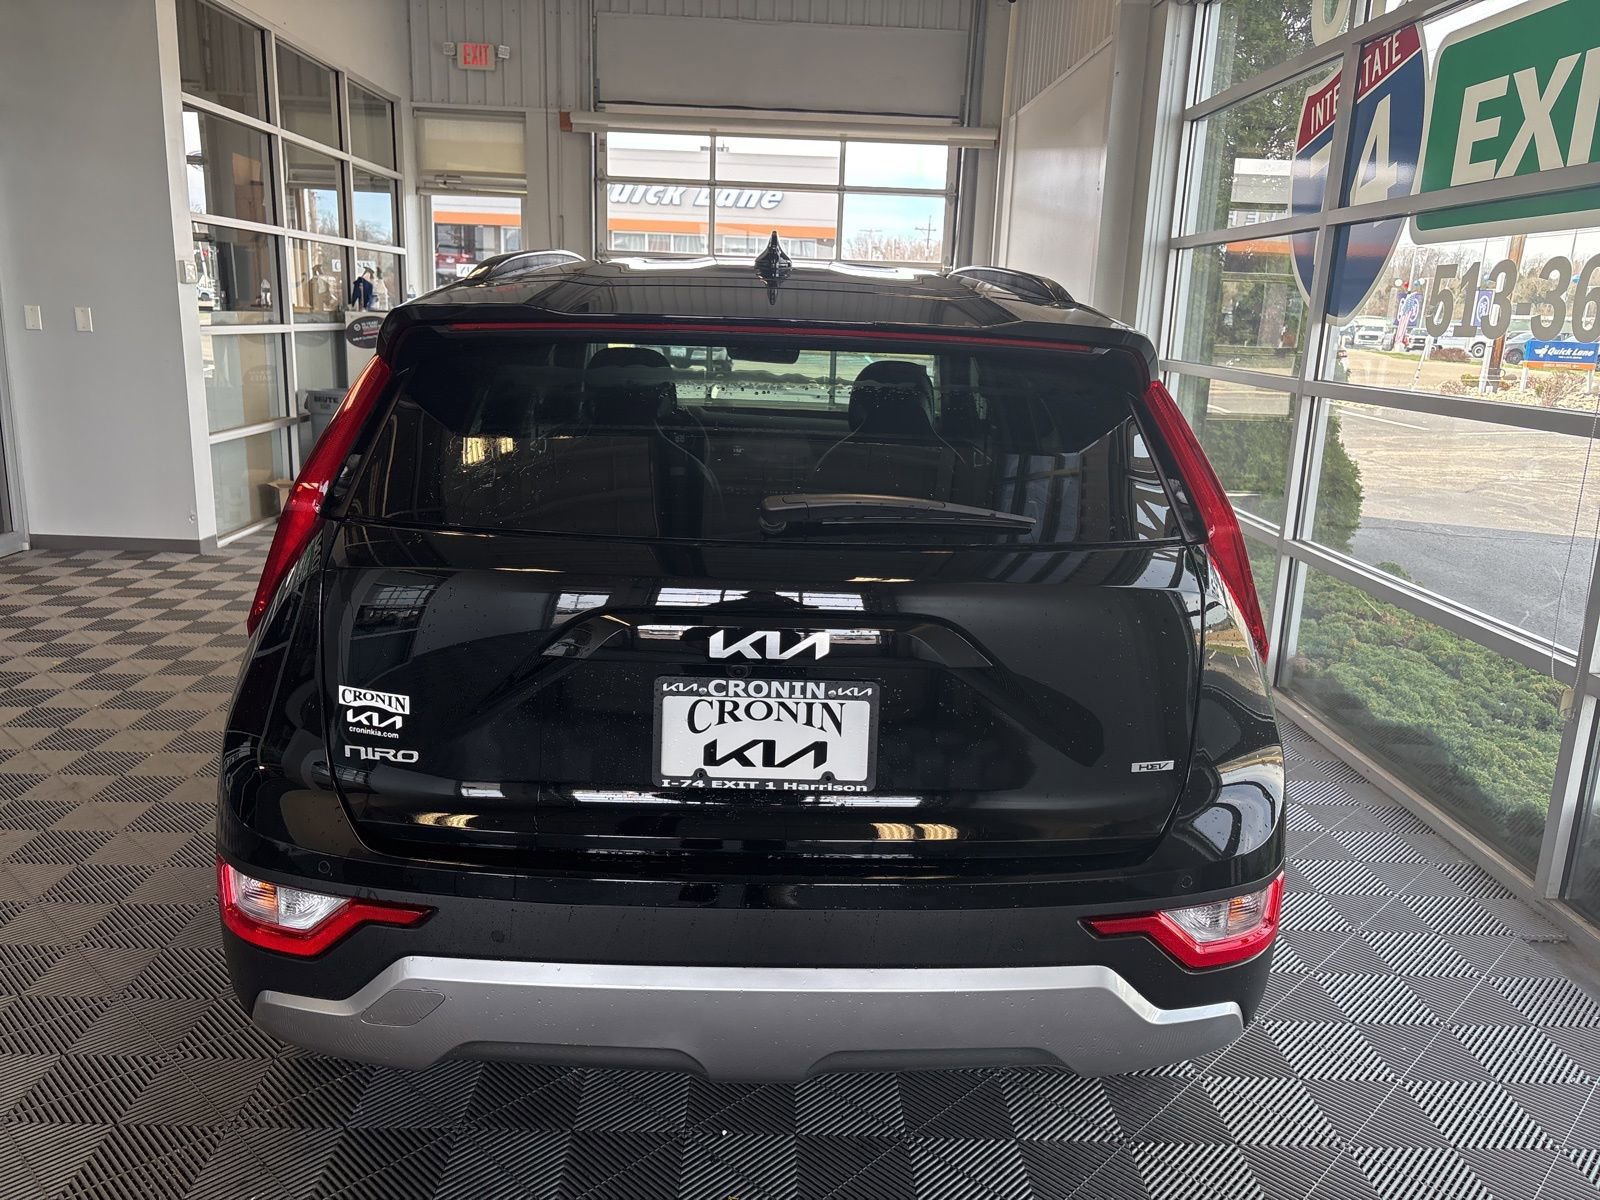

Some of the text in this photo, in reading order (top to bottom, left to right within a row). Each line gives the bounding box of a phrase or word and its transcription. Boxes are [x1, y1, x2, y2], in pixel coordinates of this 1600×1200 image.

[463, 43, 489, 65] EXIT
[1310, 34, 1402, 135] INTETATE
[608, 184, 686, 206] uick
[1547, 346, 1595, 357] Quick Lane
[709, 630, 830, 660] KIA
[341, 687, 407, 713] CRONIN
[662, 679, 872, 699] KIA CRONIN KIA
[346, 708, 403, 730] KIA
[687, 698, 846, 737] CRONIN
[348, 725, 399, 739] croninkia.com
[703, 738, 828, 769] KIA
[661, 779, 868, 792] I-74 EXIT 1 Harrison
